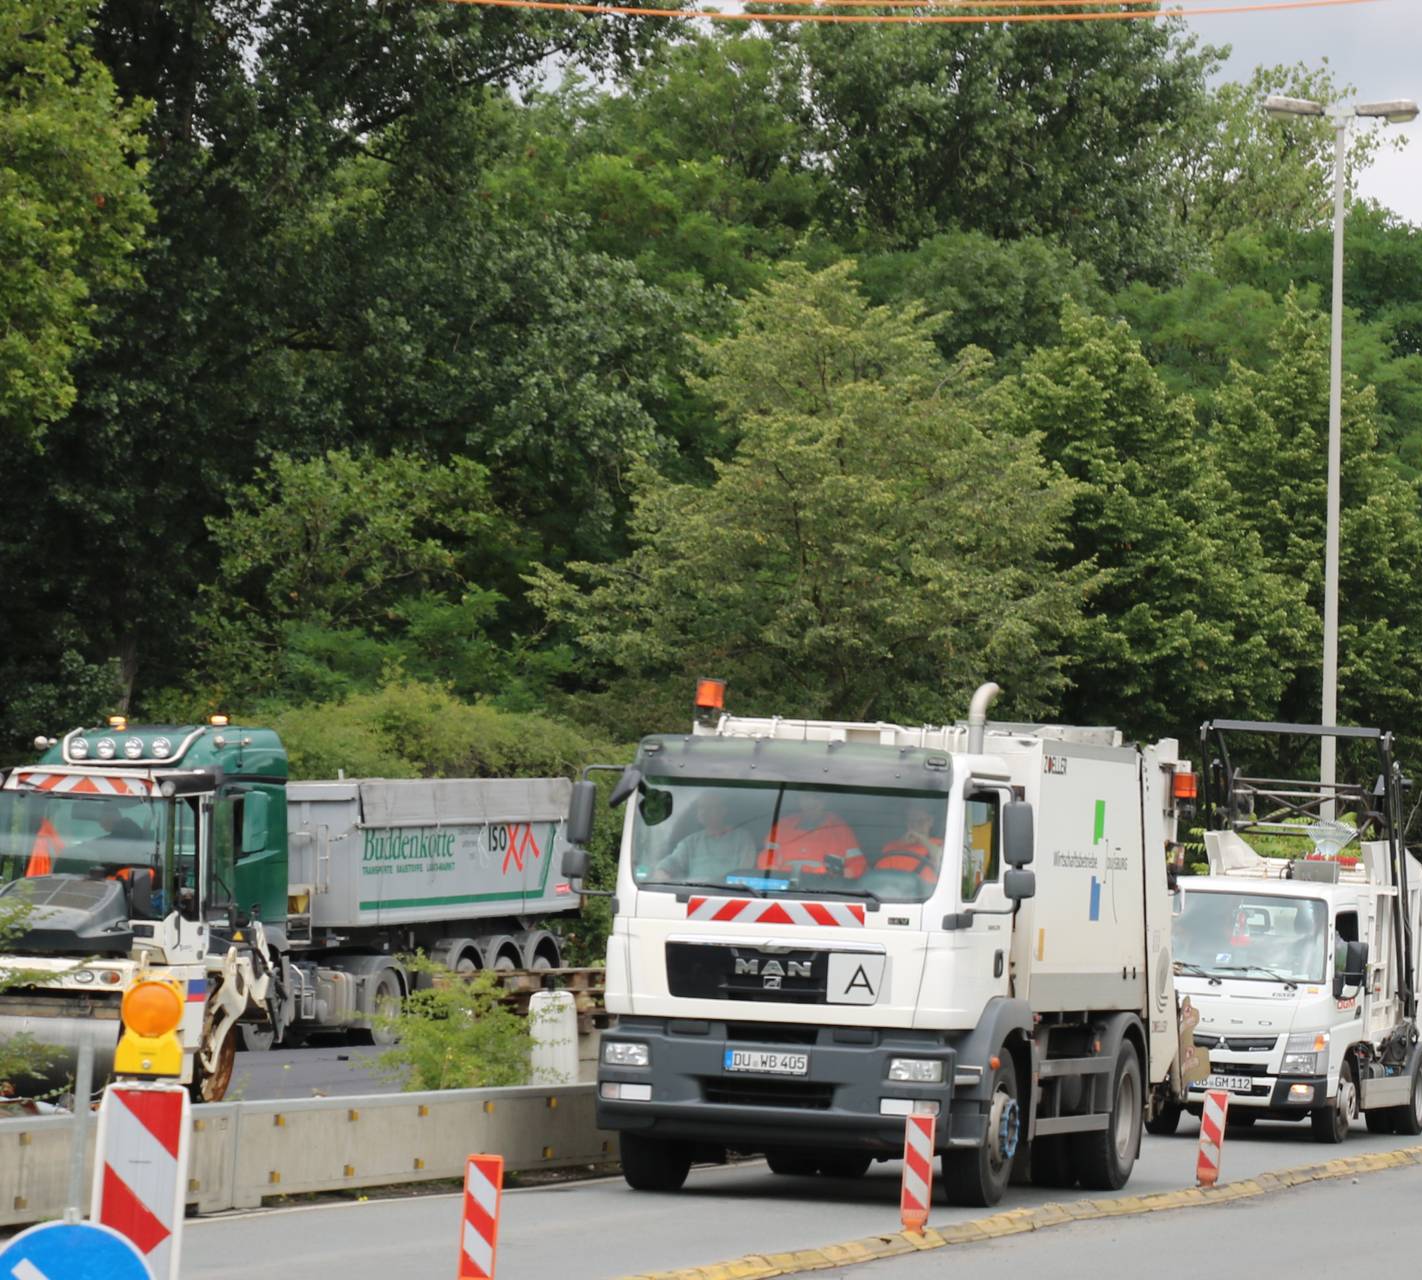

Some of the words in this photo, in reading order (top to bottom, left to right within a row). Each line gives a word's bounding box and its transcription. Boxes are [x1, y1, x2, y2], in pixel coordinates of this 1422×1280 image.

[735, 958, 812, 977] MAN
[844, 963, 875, 996] A
[734, 1053, 751, 1067] DU
[760, 1055, 778, 1068] WB
[780, 1056, 806, 1070] 405
[1215, 1077, 1229, 1088] GM
[1231, 1078, 1251, 1090] 112
